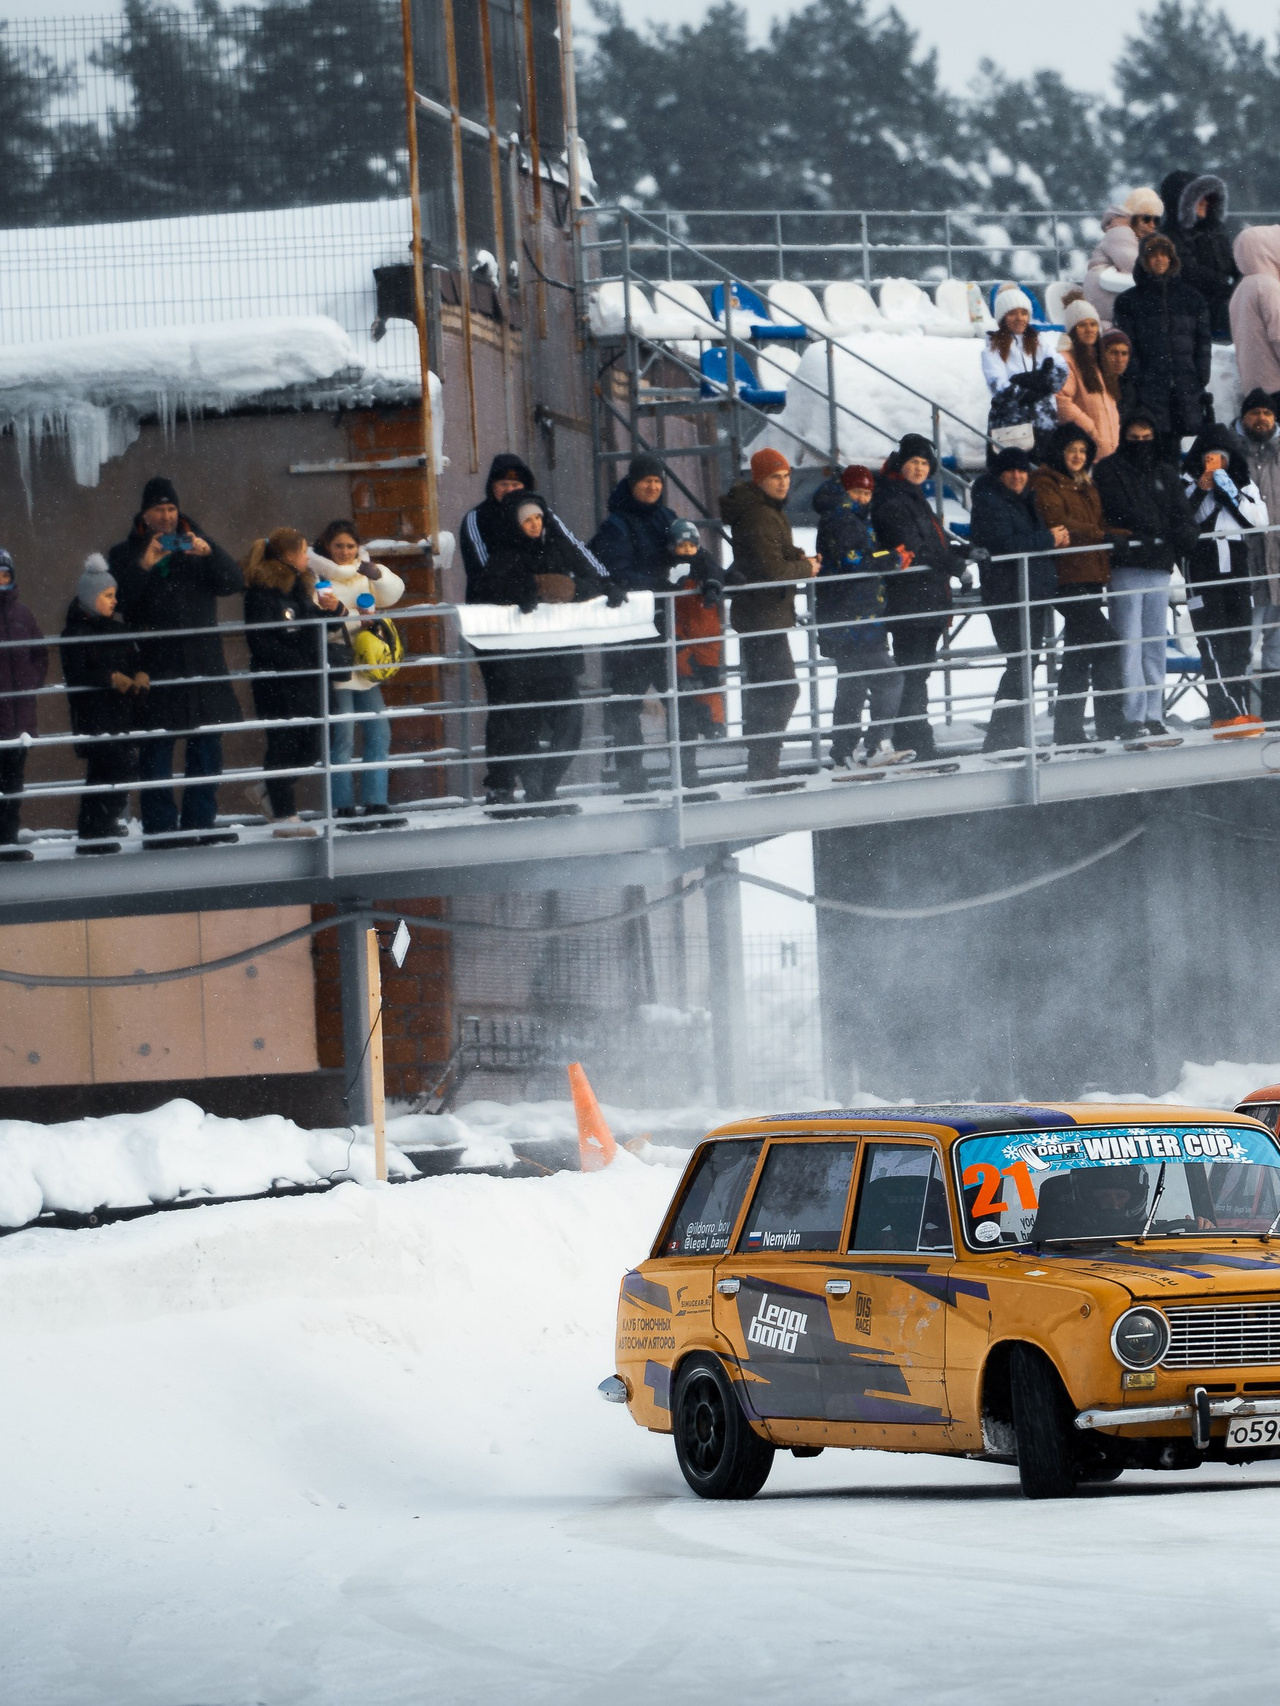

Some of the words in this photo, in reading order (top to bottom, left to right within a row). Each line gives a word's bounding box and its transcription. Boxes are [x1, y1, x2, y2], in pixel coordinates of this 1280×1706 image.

[1037, 1142, 1081, 1157] DRIFT
[1082, 1134, 1183, 1161] WINTER
[1182, 1133, 1234, 1157] CUP
[962, 1160, 1040, 1219] 21
[762, 1229, 801, 1249] Nemykin
